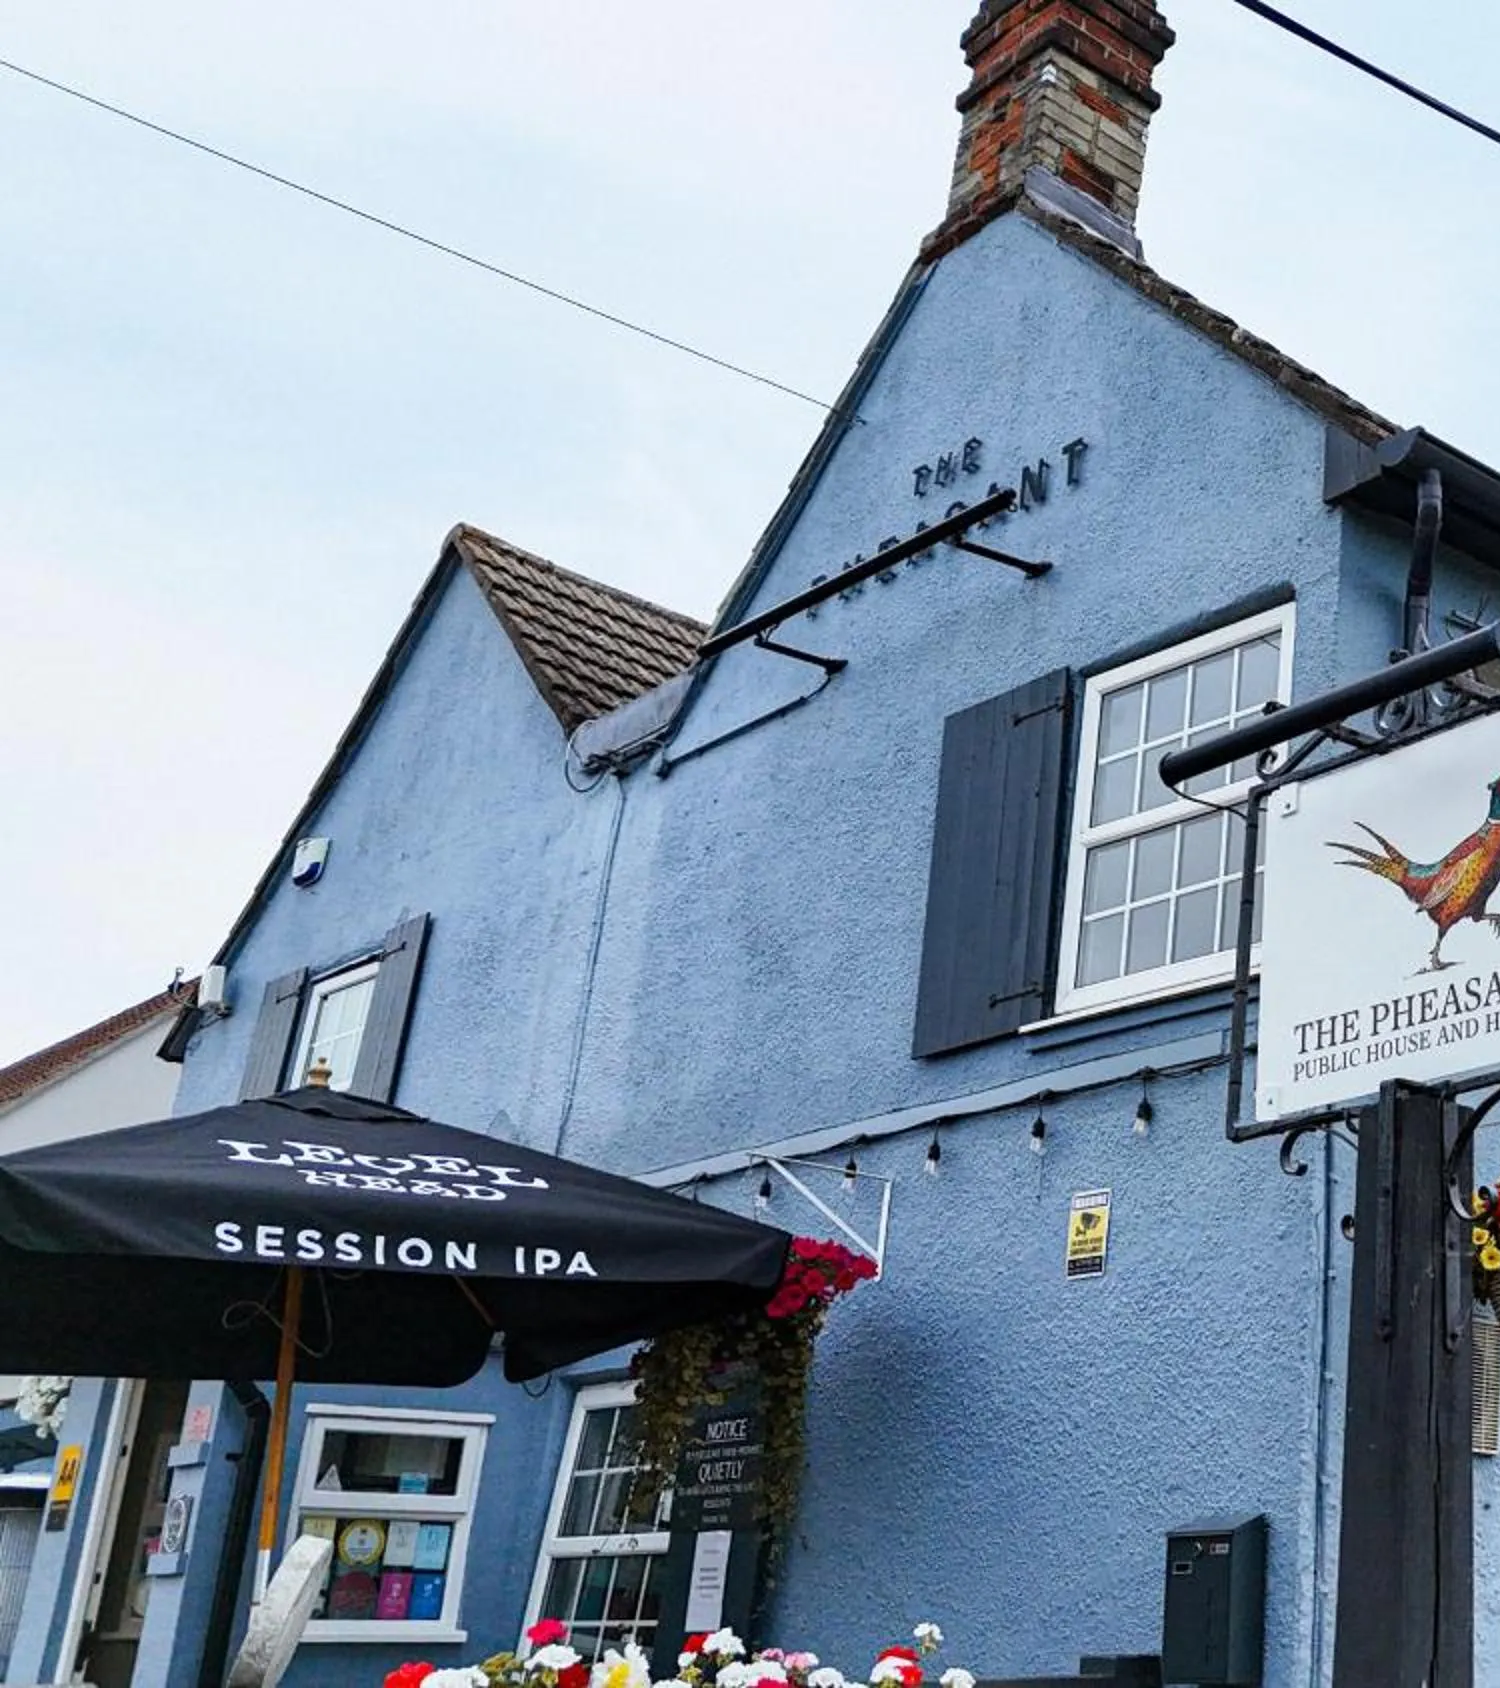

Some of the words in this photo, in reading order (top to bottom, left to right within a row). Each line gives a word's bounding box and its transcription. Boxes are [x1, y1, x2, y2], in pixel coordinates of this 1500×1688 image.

[913, 436, 982, 498] THE
[1293, 1009, 1361, 1055] THE
[1293, 1047, 1362, 1083] PUBLIC
[1366, 1029, 1432, 1065] HOUSE
[1436, 1017, 1480, 1047] AND
[216, 1139, 549, 1190] LEVEL
[297, 1169, 507, 1201] HEAD
[214, 1221, 478, 1271] SESSION
[514, 1246, 599, 1277] IPA
[706, 1417, 748, 1440] NOTICE
[58, 1457, 78, 1485] AA
[698, 1460, 745, 1483] QUIETLY
